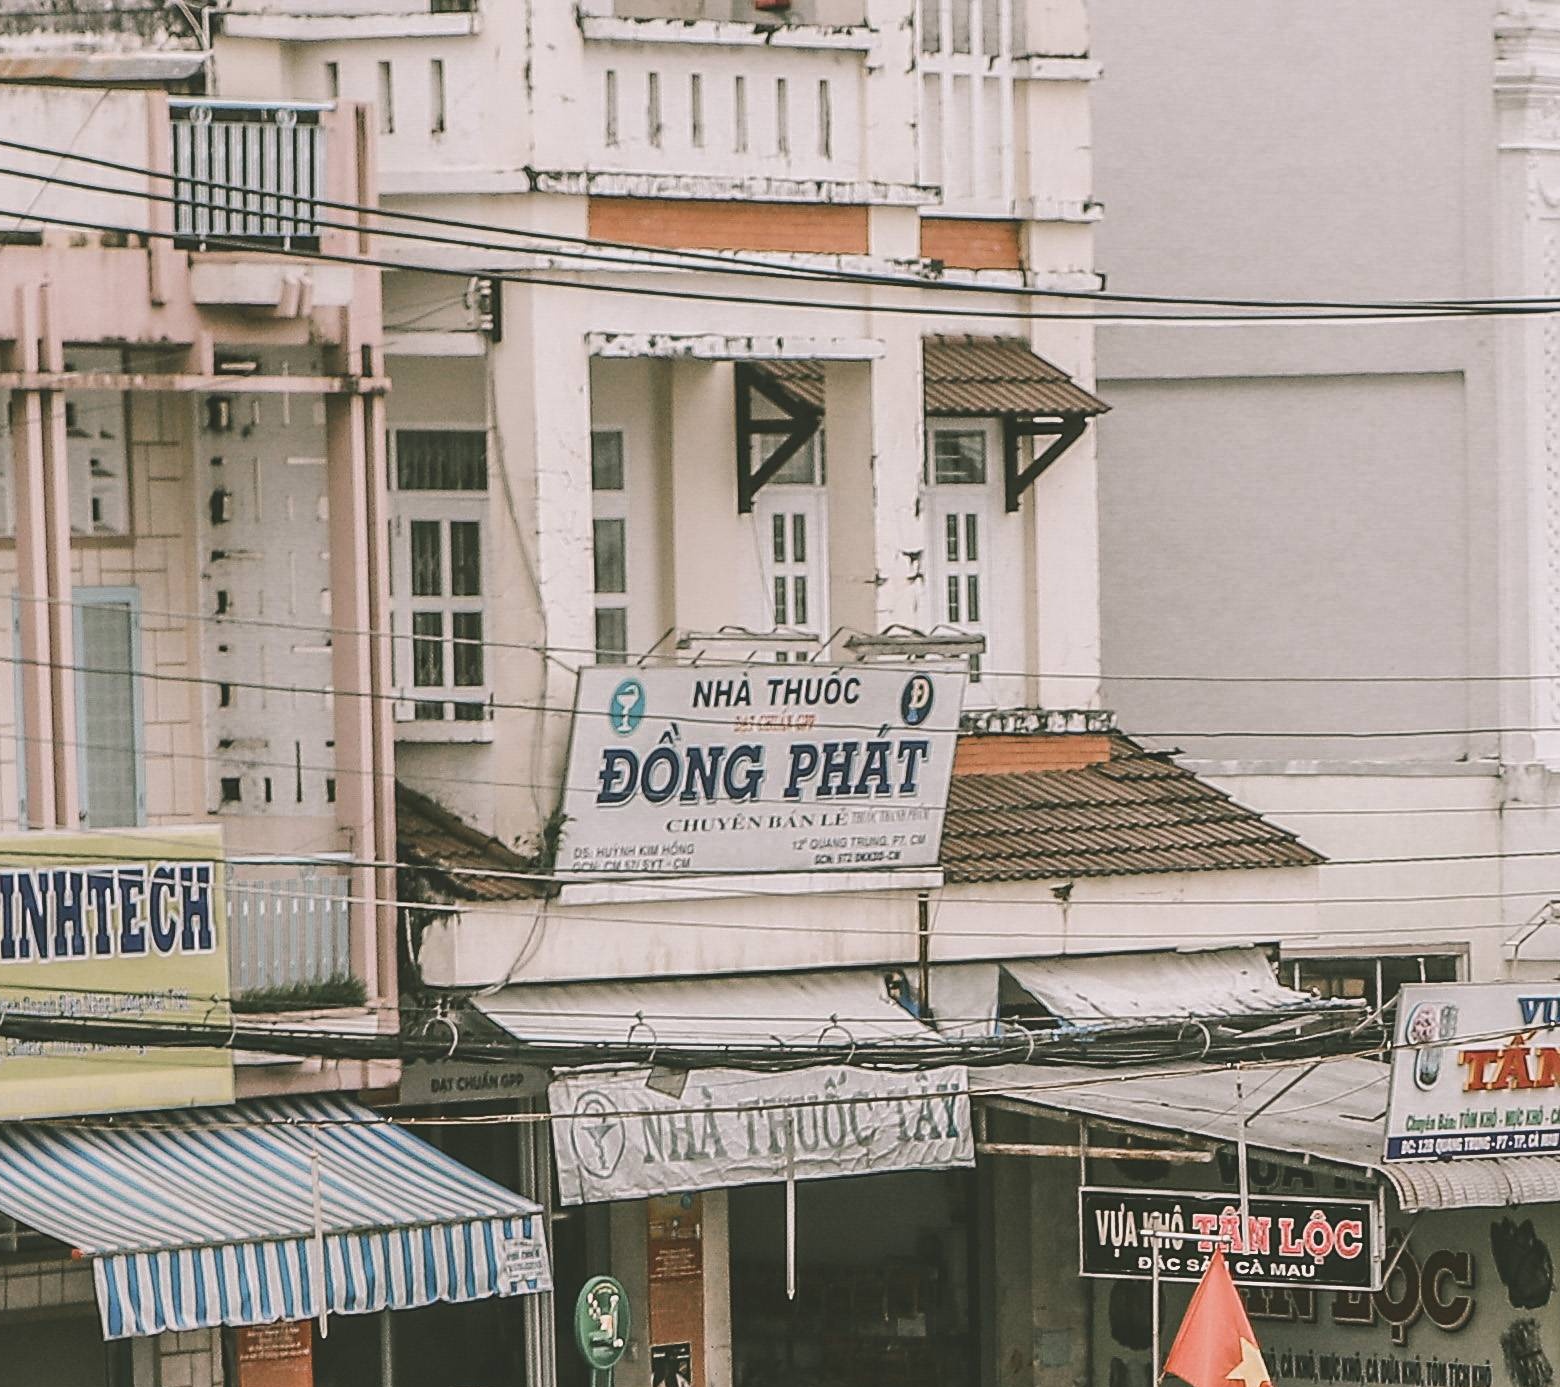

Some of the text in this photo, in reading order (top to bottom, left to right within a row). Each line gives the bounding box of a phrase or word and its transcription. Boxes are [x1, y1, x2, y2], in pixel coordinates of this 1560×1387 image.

[692, 670, 862, 708] NHÀ THUỐC
[596, 722, 930, 806] ĐỒNG PHÁT
[768, 808, 818, 829] BÁN
[641, 1085, 730, 1165] NHÀ
[1095, 1202, 1139, 1259] VỰA
[1140, 1204, 1185, 1251] KHÔ
[1278, 1209, 1363, 1265] LỘC
[1234, 1254, 1265, 1276] CÀ
[1269, 1261, 1316, 1279] MAU
